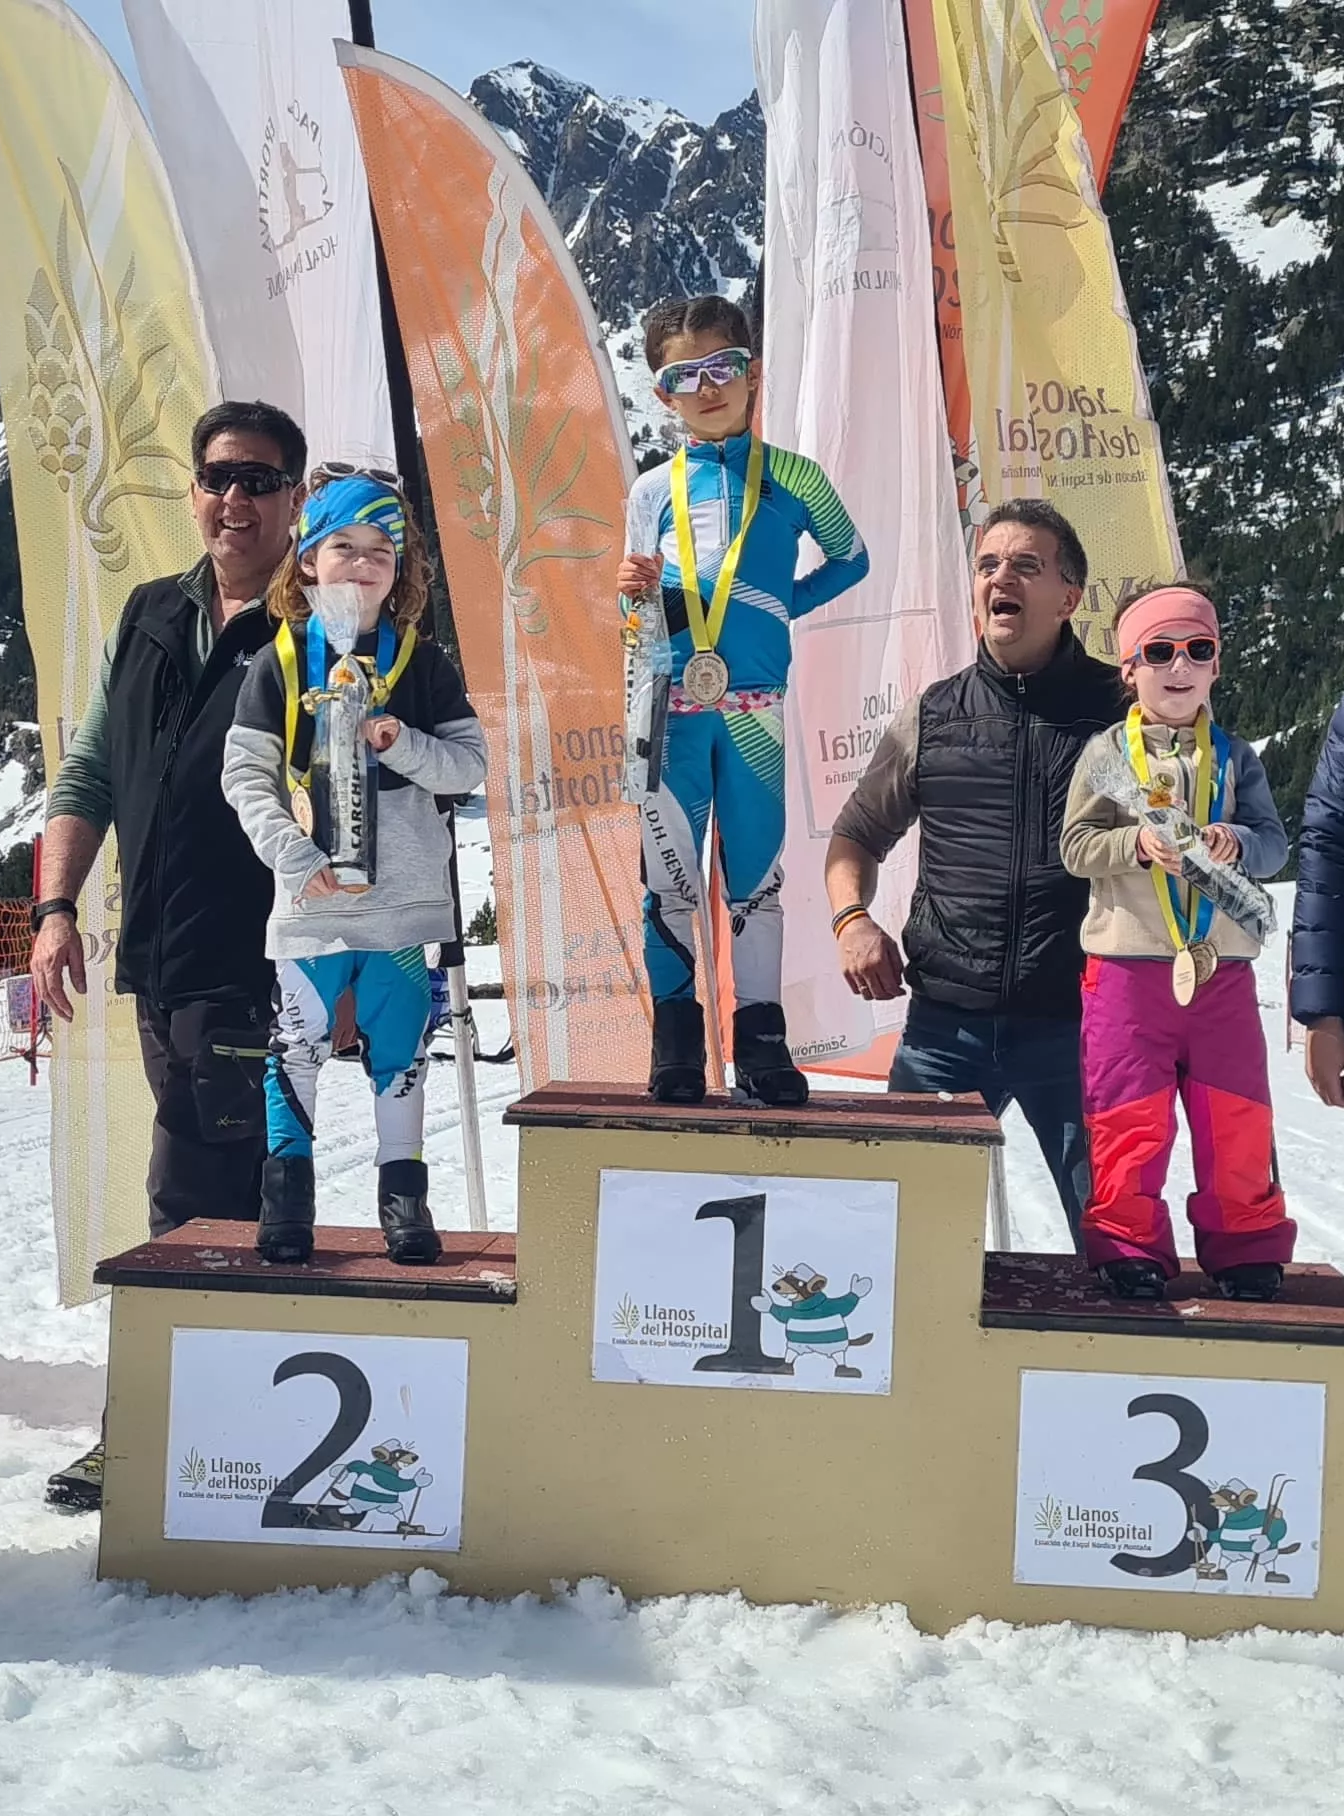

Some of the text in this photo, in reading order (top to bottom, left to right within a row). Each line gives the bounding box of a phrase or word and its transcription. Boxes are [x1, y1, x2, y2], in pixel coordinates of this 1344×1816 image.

[644, 1304, 695, 1321] Llanos
[693, 1193, 794, 1376] 1
[211, 1457, 262, 1474] Llanos
[261, 1351, 372, 1529] 2
[1109, 1392, 1220, 1578] 3
[1067, 1505, 1119, 1522] Llanos
